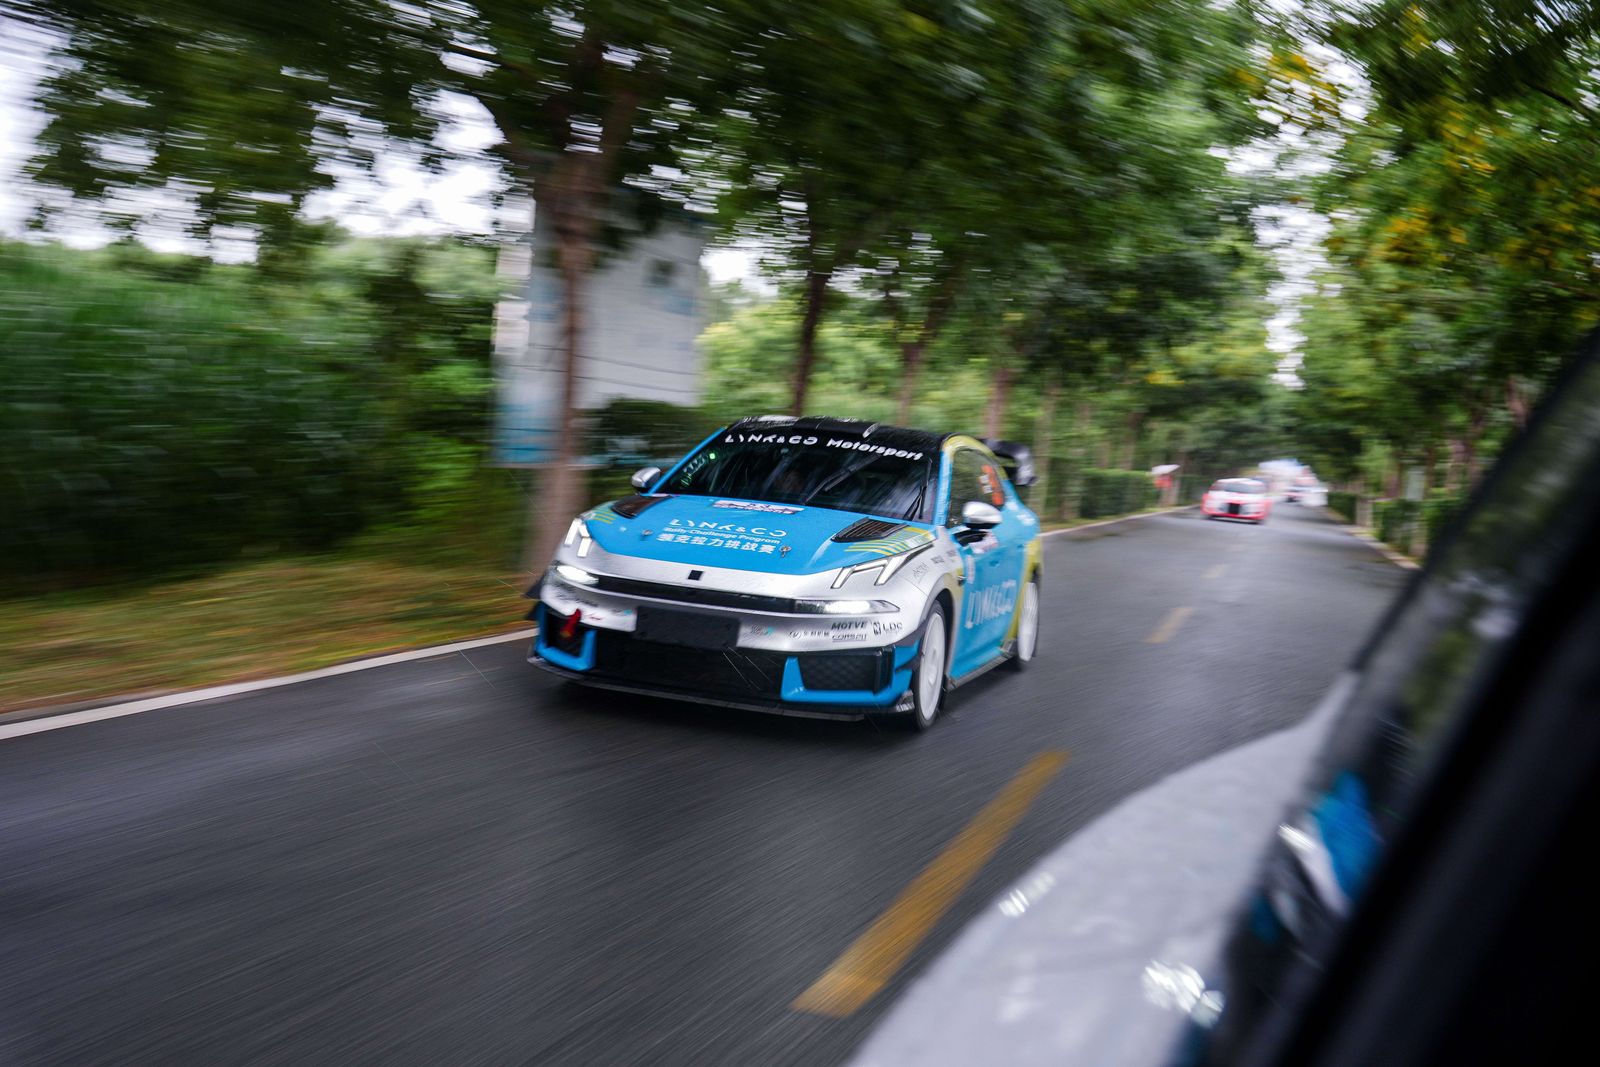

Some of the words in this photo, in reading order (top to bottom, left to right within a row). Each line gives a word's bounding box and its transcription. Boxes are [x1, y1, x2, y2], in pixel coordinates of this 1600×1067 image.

[826, 438, 924, 461] Motorsport
[688, 529, 738, 540] Challenge
[738, 534, 782, 545] Program
